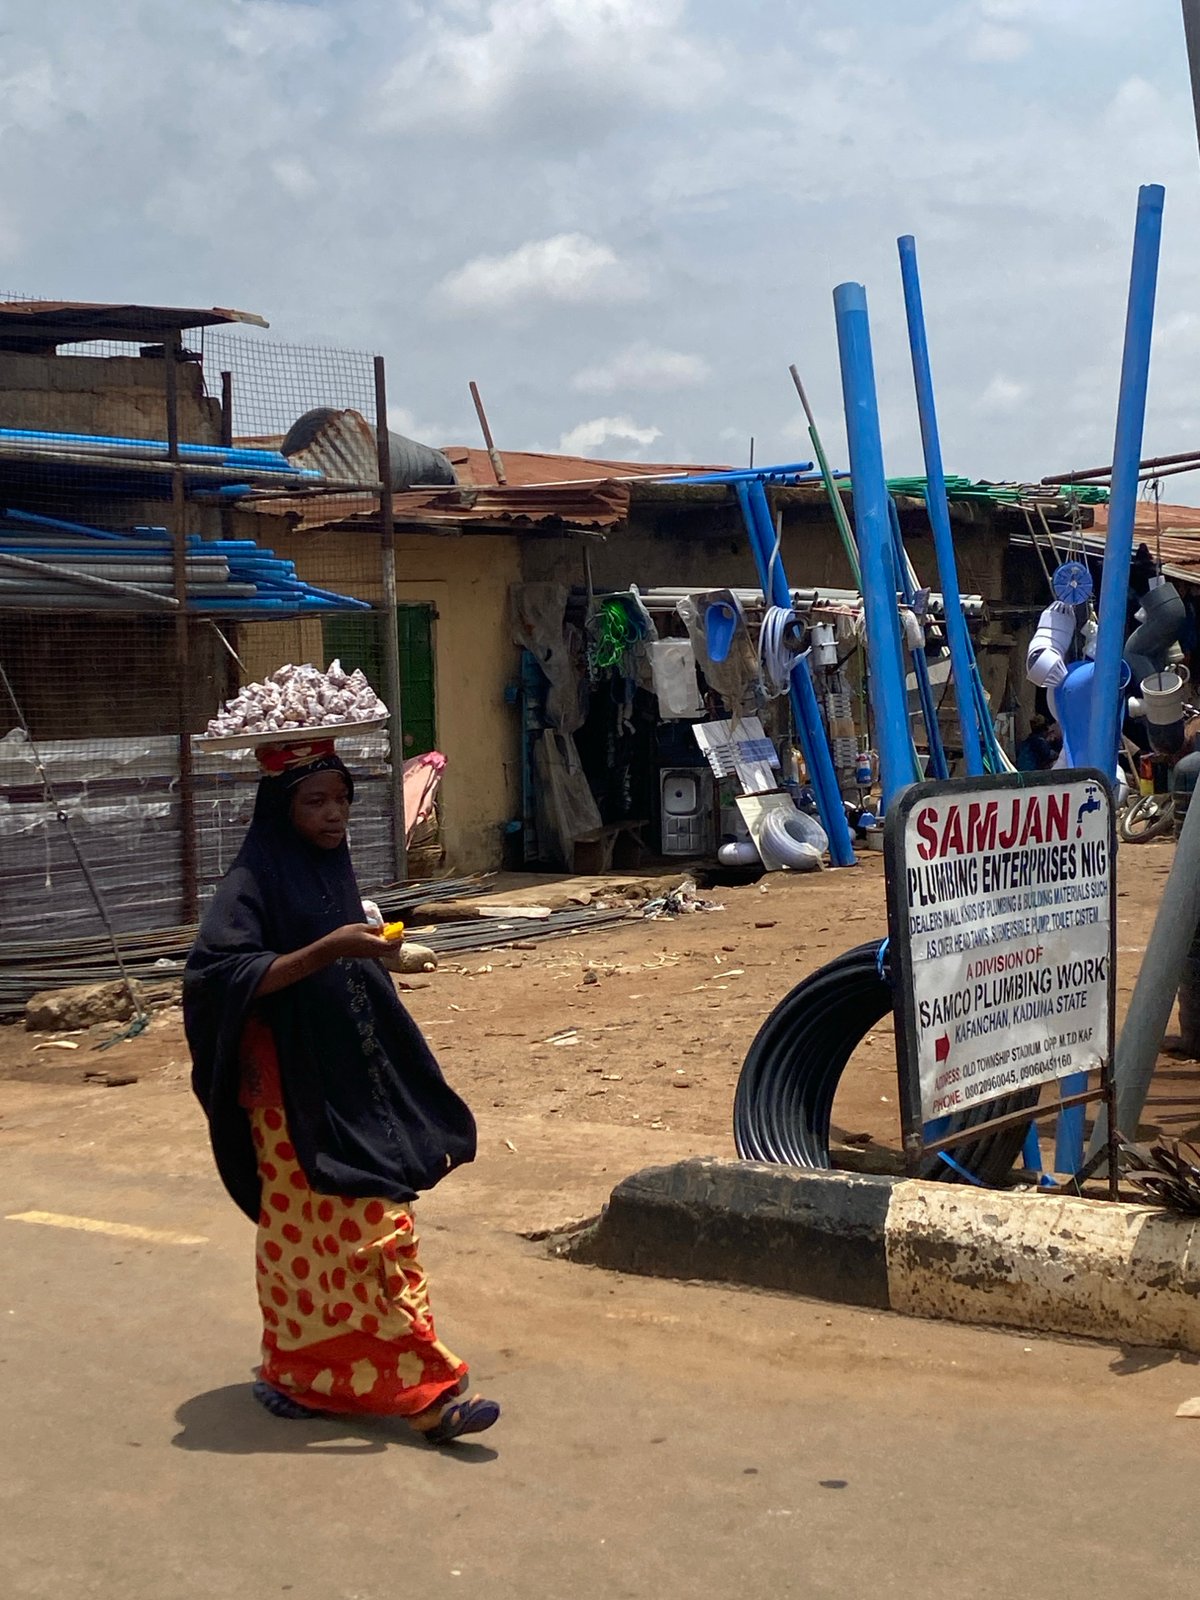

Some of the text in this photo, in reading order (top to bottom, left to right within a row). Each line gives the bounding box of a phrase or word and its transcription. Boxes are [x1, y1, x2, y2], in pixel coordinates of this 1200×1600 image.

[916, 793, 1071, 861] SAMJAN
[907, 840, 1106, 907] PLUMBING ENTERPRISES NIG
[909, 911, 943, 935] DEALERS
[950, 908, 961, 926] ALL
[977, 901, 985, 919] OF
[986, 895, 1017, 917] PLUMBING
[1023, 888, 1053, 909] BUILDING
[1054, 883, 1090, 904] MATERIALS
[1090, 880, 1108, 898] SUCH
[927, 940, 937, 960] AS
[966, 946, 1043, 981] A DIVISION OF
[919, 957, 1106, 1028] SAMCO PLUMBING WORK
[955, 990, 1088, 1044] KAFANCHAN, KADUNA STATE
[962, 1061, 976, 1078] OLD
[977, 1049, 1010, 1071] TOWNSHIP
[1011, 1041, 1041, 1061] STADIUM
[1078, 1027, 1093, 1043] KAF
